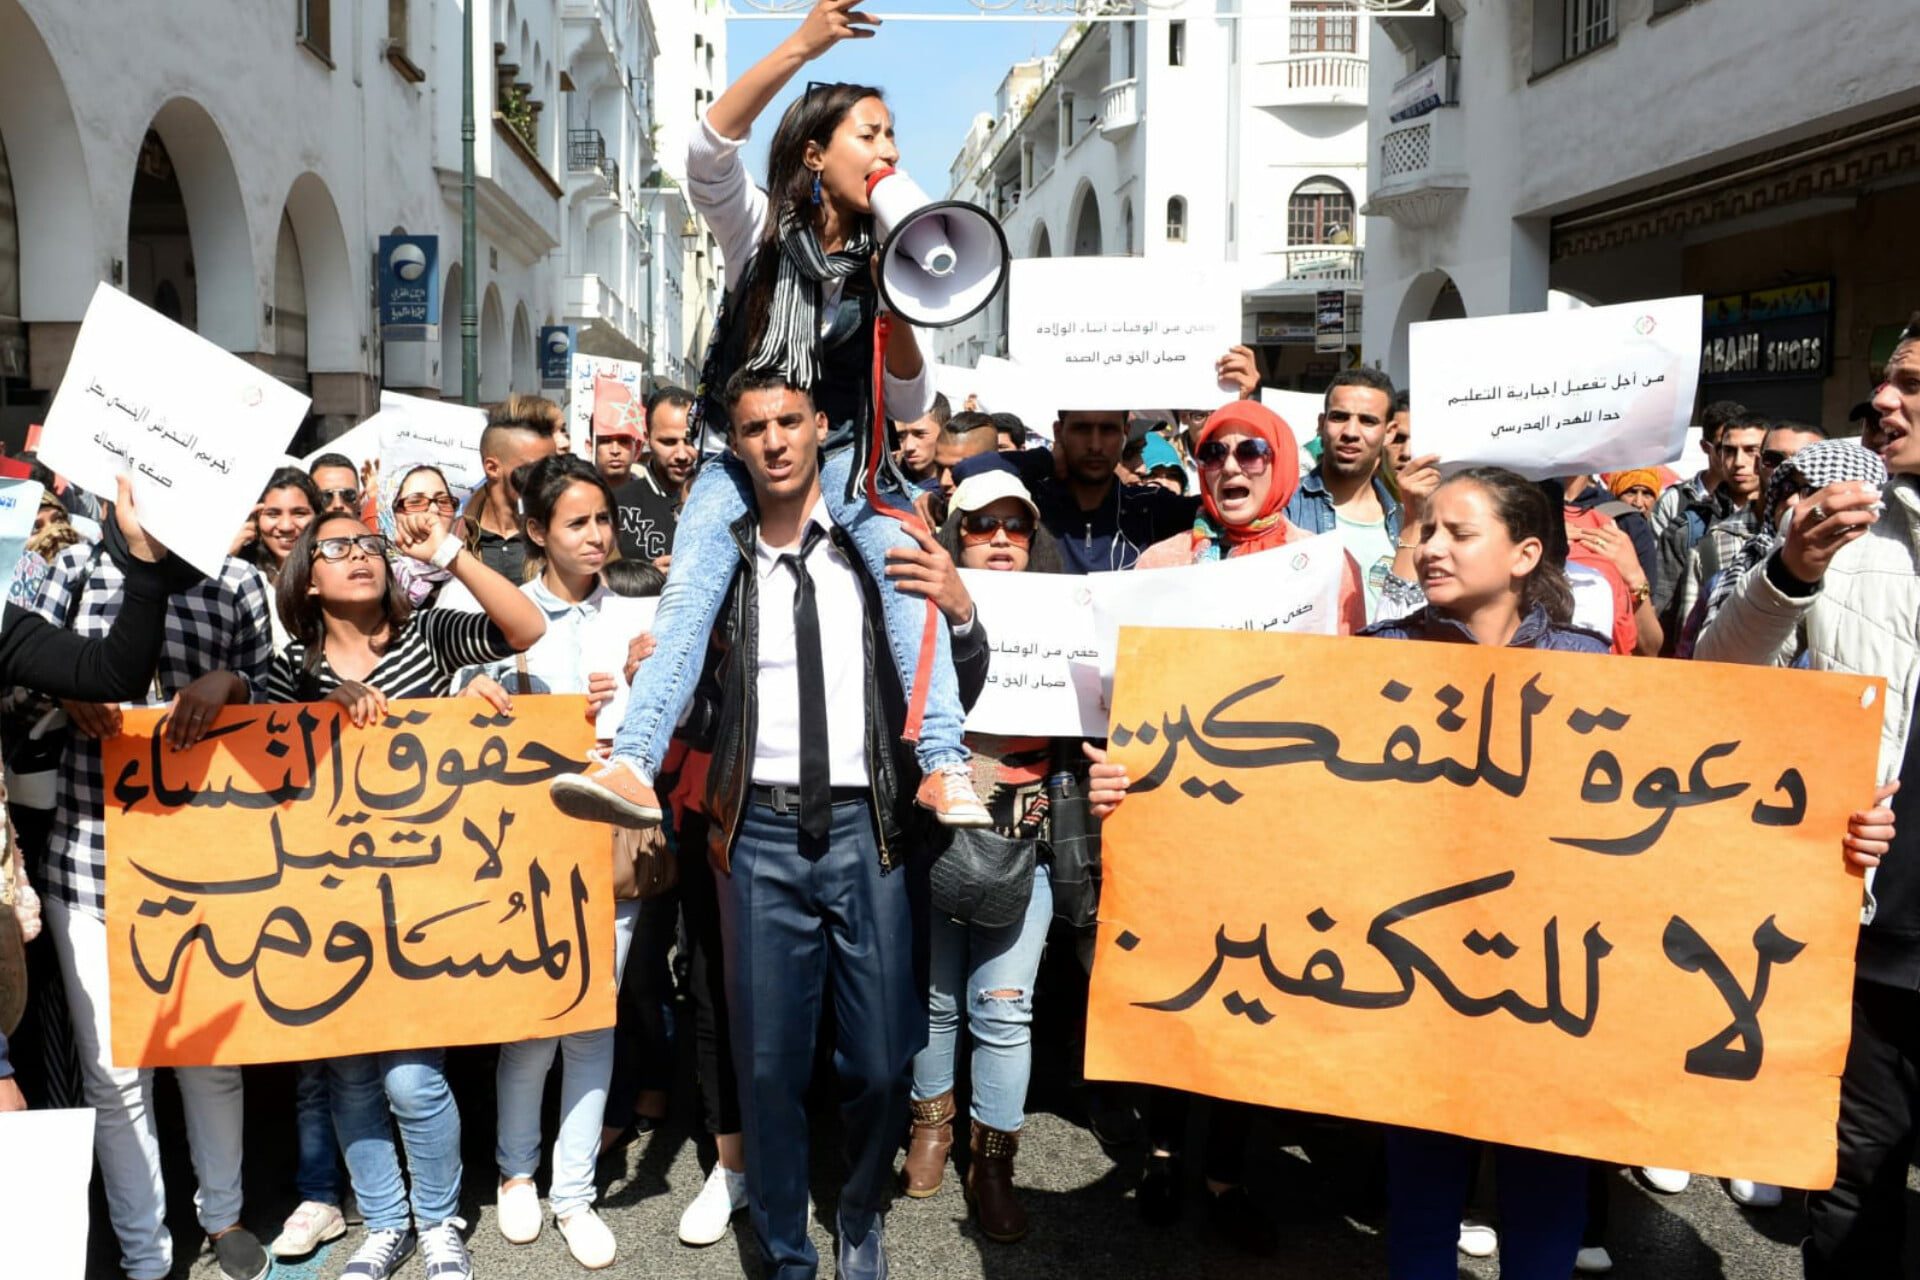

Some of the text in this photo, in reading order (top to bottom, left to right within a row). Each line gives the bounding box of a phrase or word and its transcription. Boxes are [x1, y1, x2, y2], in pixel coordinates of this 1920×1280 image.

[1766, 337, 1822, 372] SHOES
[1447, 370, 1666, 407] من أجل تفعيل إجبارية التعليم
[1490, 415, 1551, 440] المدرسي
[1555, 411, 1593, 430] للهدر
[618, 505, 666, 560] NYC
[1041, 648, 1062, 659] من
[1066, 648, 1099, 660] كفى
[1030, 673, 1067, 689] ضمان
[353, 708, 594, 825] حقوق
[1549, 705, 1808, 856] دعوة
[127, 807, 516, 896] لا تقبل
[1661, 912, 1808, 1081] لا
